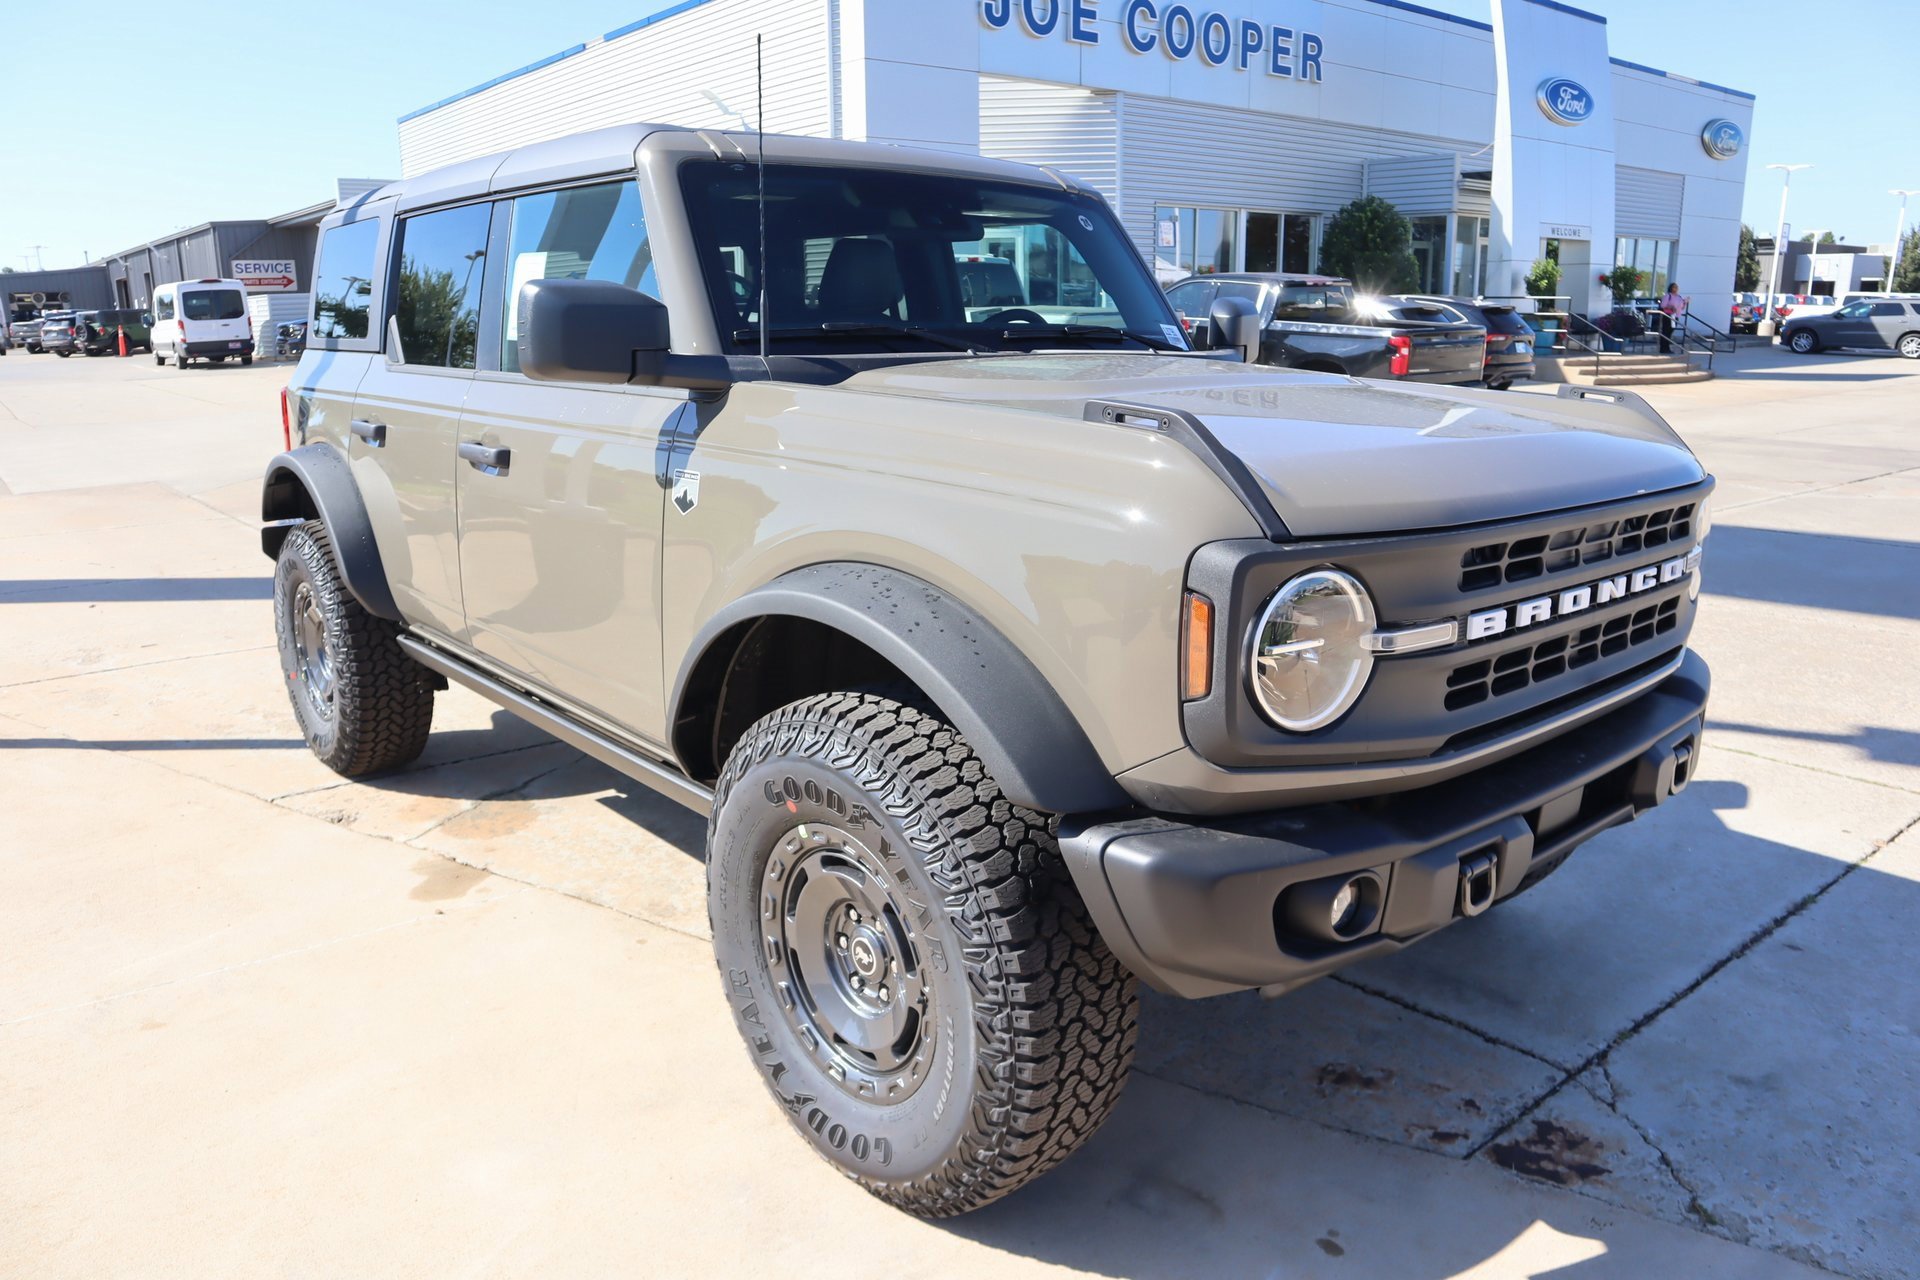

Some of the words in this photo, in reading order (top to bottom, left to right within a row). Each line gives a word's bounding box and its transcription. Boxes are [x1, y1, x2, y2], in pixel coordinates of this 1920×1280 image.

[1124, 0, 1323, 83] COOPER
[1557, 86, 1586, 115] Ford
[235, 262, 292, 274] SERVICE
[1551, 227, 1582, 237] WELCOME
[1466, 558, 1685, 640] BRONCO
[729, 966, 893, 1167] GOODYEAR
[932, 1015, 954, 1121] TERRITORY
